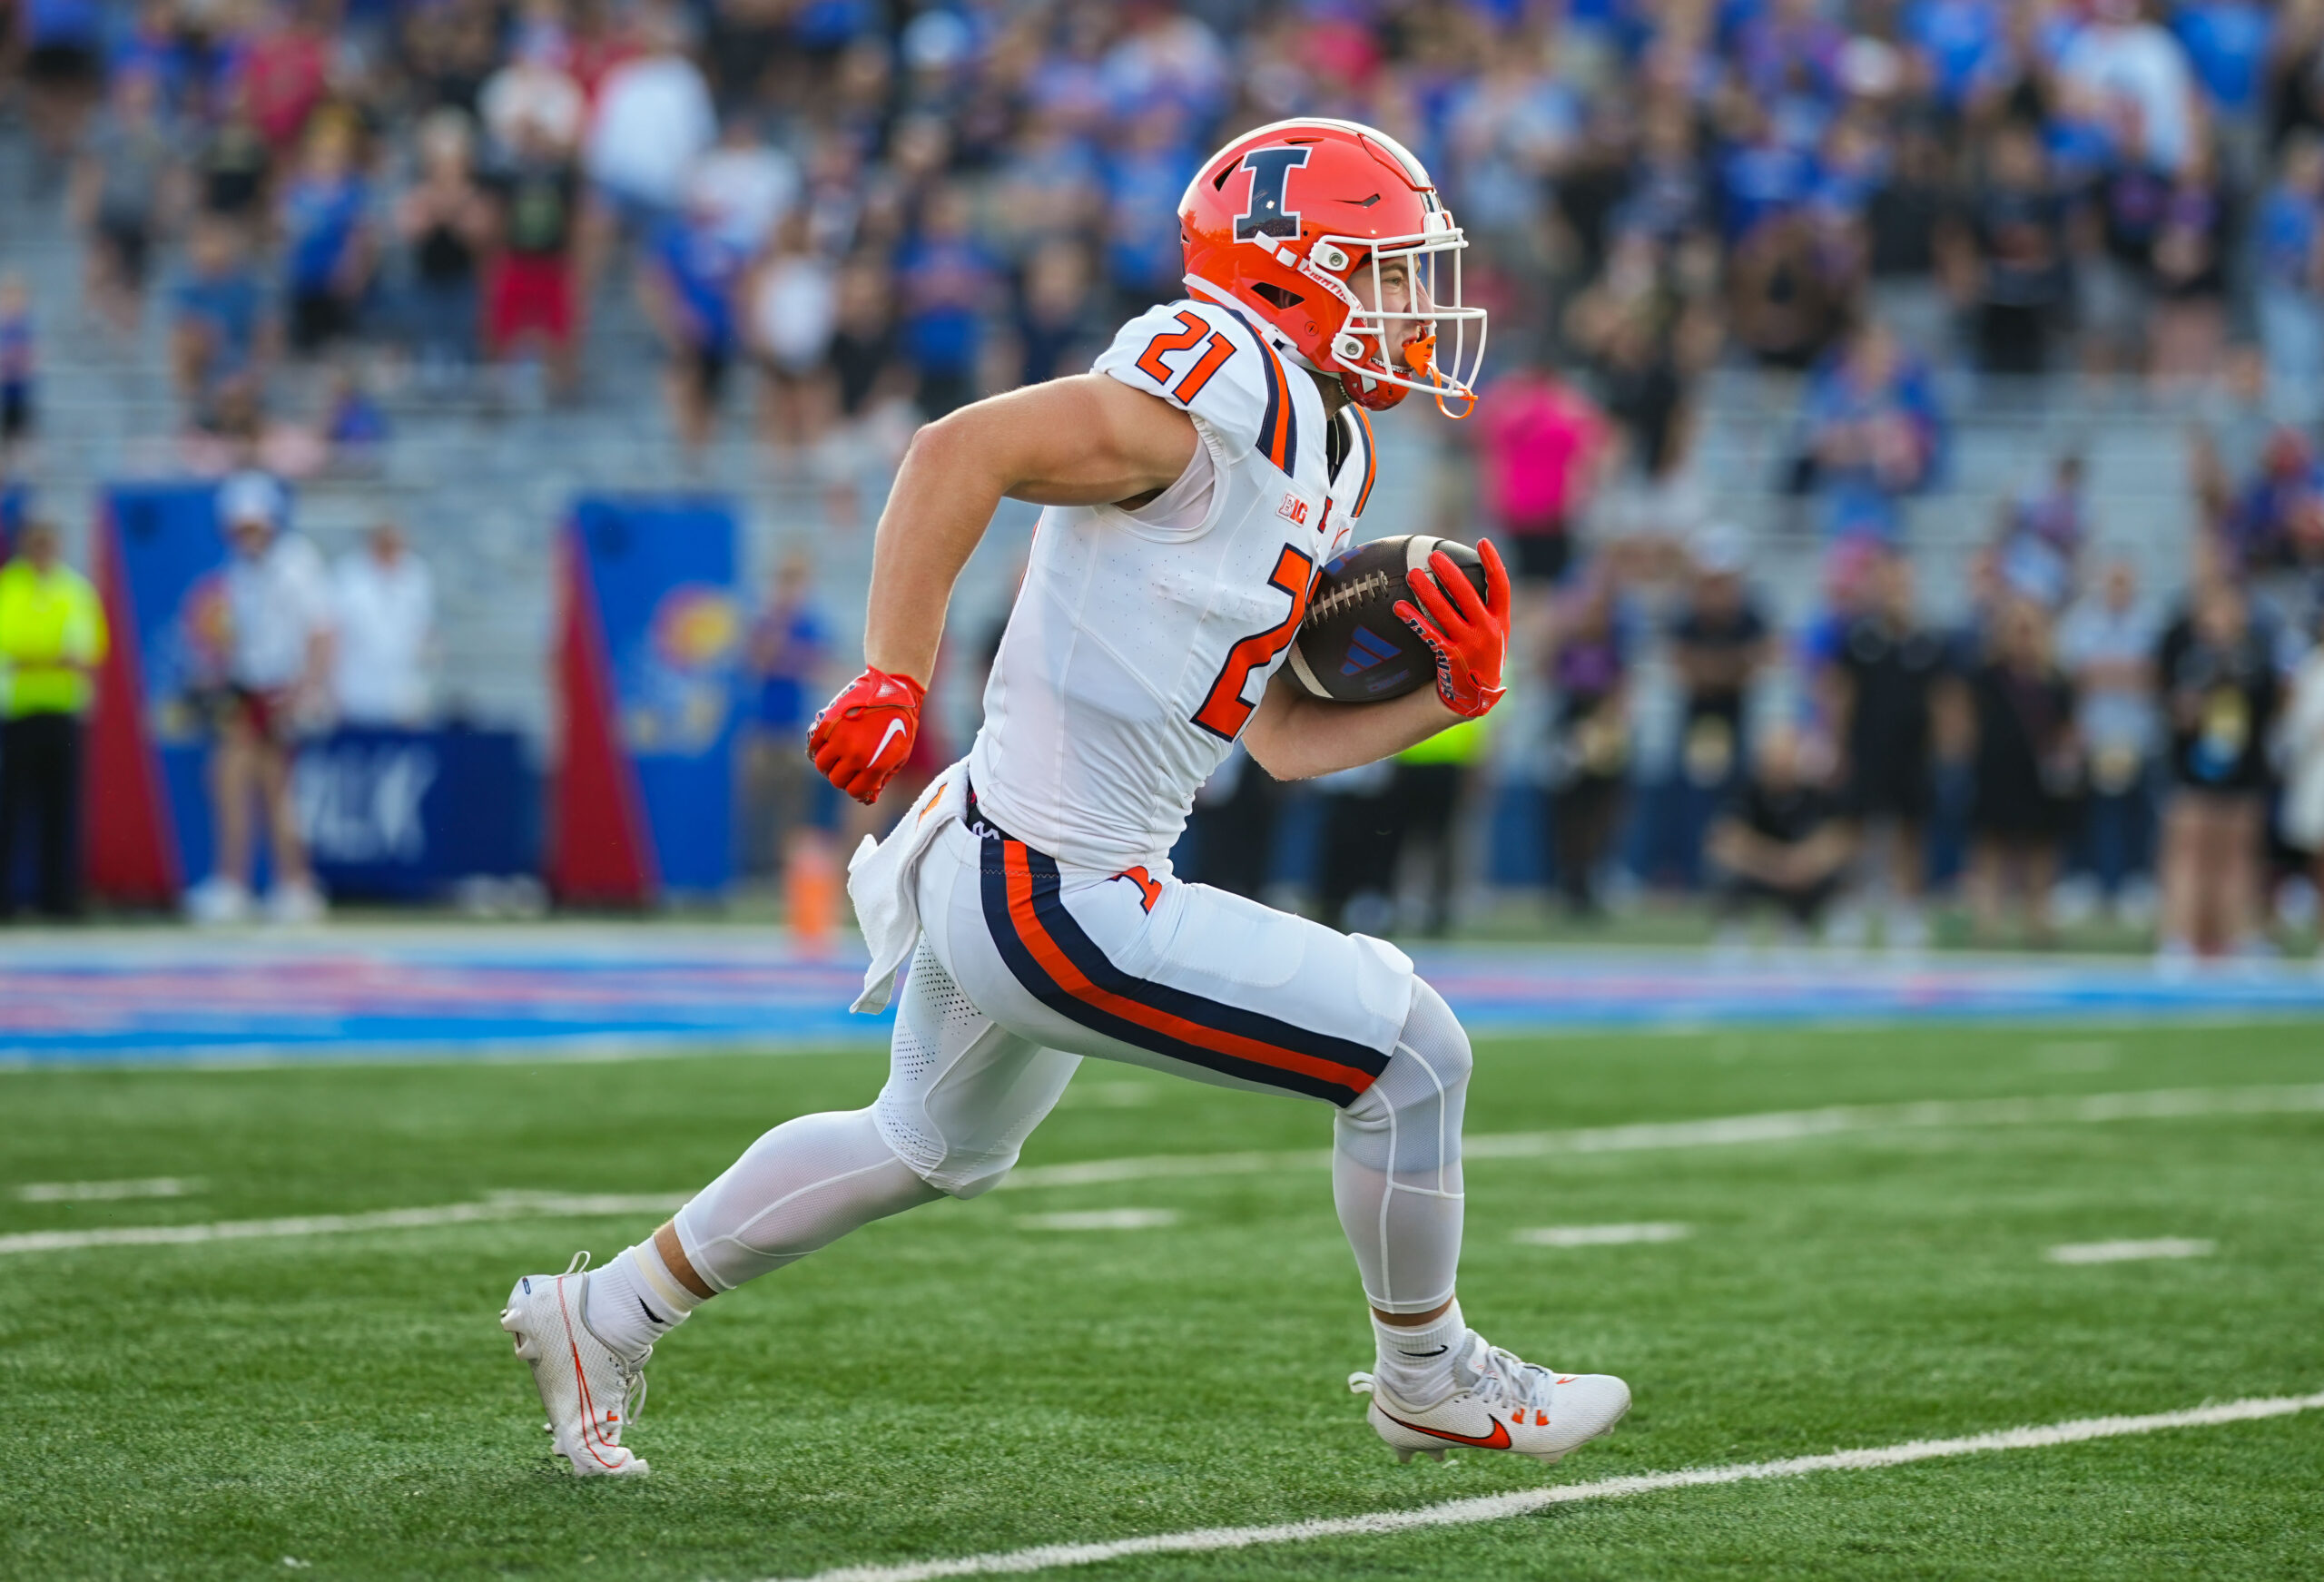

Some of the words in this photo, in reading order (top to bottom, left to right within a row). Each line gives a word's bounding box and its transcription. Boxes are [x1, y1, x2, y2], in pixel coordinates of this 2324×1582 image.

[1233, 145, 1314, 244] I
[1134, 310, 1237, 406] 21
[1278, 493, 1308, 525] BIG
[1189, 542, 1324, 743] 2
